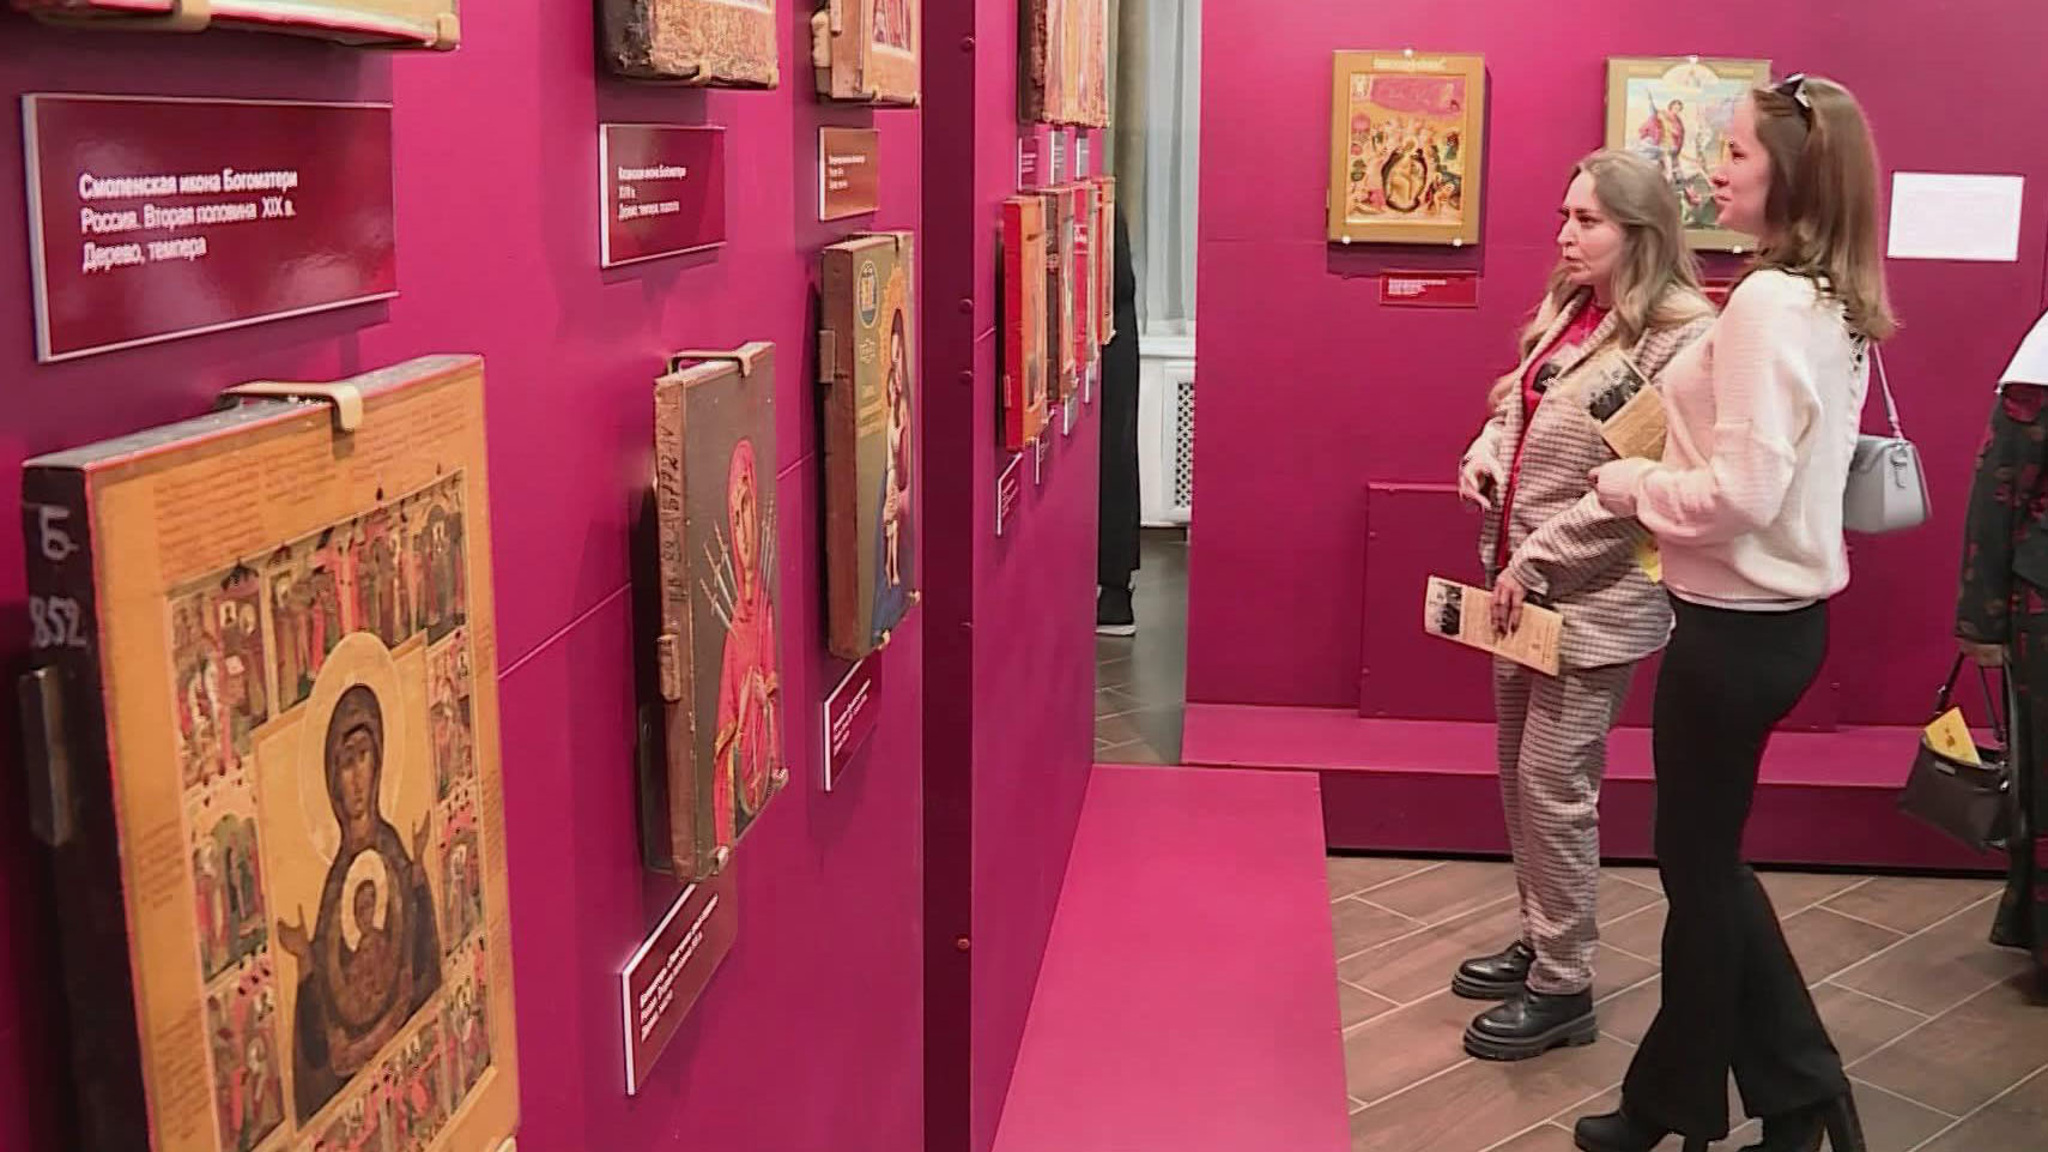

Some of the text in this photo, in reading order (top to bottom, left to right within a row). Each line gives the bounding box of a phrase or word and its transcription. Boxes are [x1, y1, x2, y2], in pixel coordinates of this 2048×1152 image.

[79, 168, 298, 198] Смоленская икона Богоматери
[80, 207, 142, 233] Россия.
[143, 203, 195, 230] Вторая
[196, 203, 257, 224] половина
[262, 196, 283, 218] XIX
[82, 236, 207, 273] Дерево, темпера
